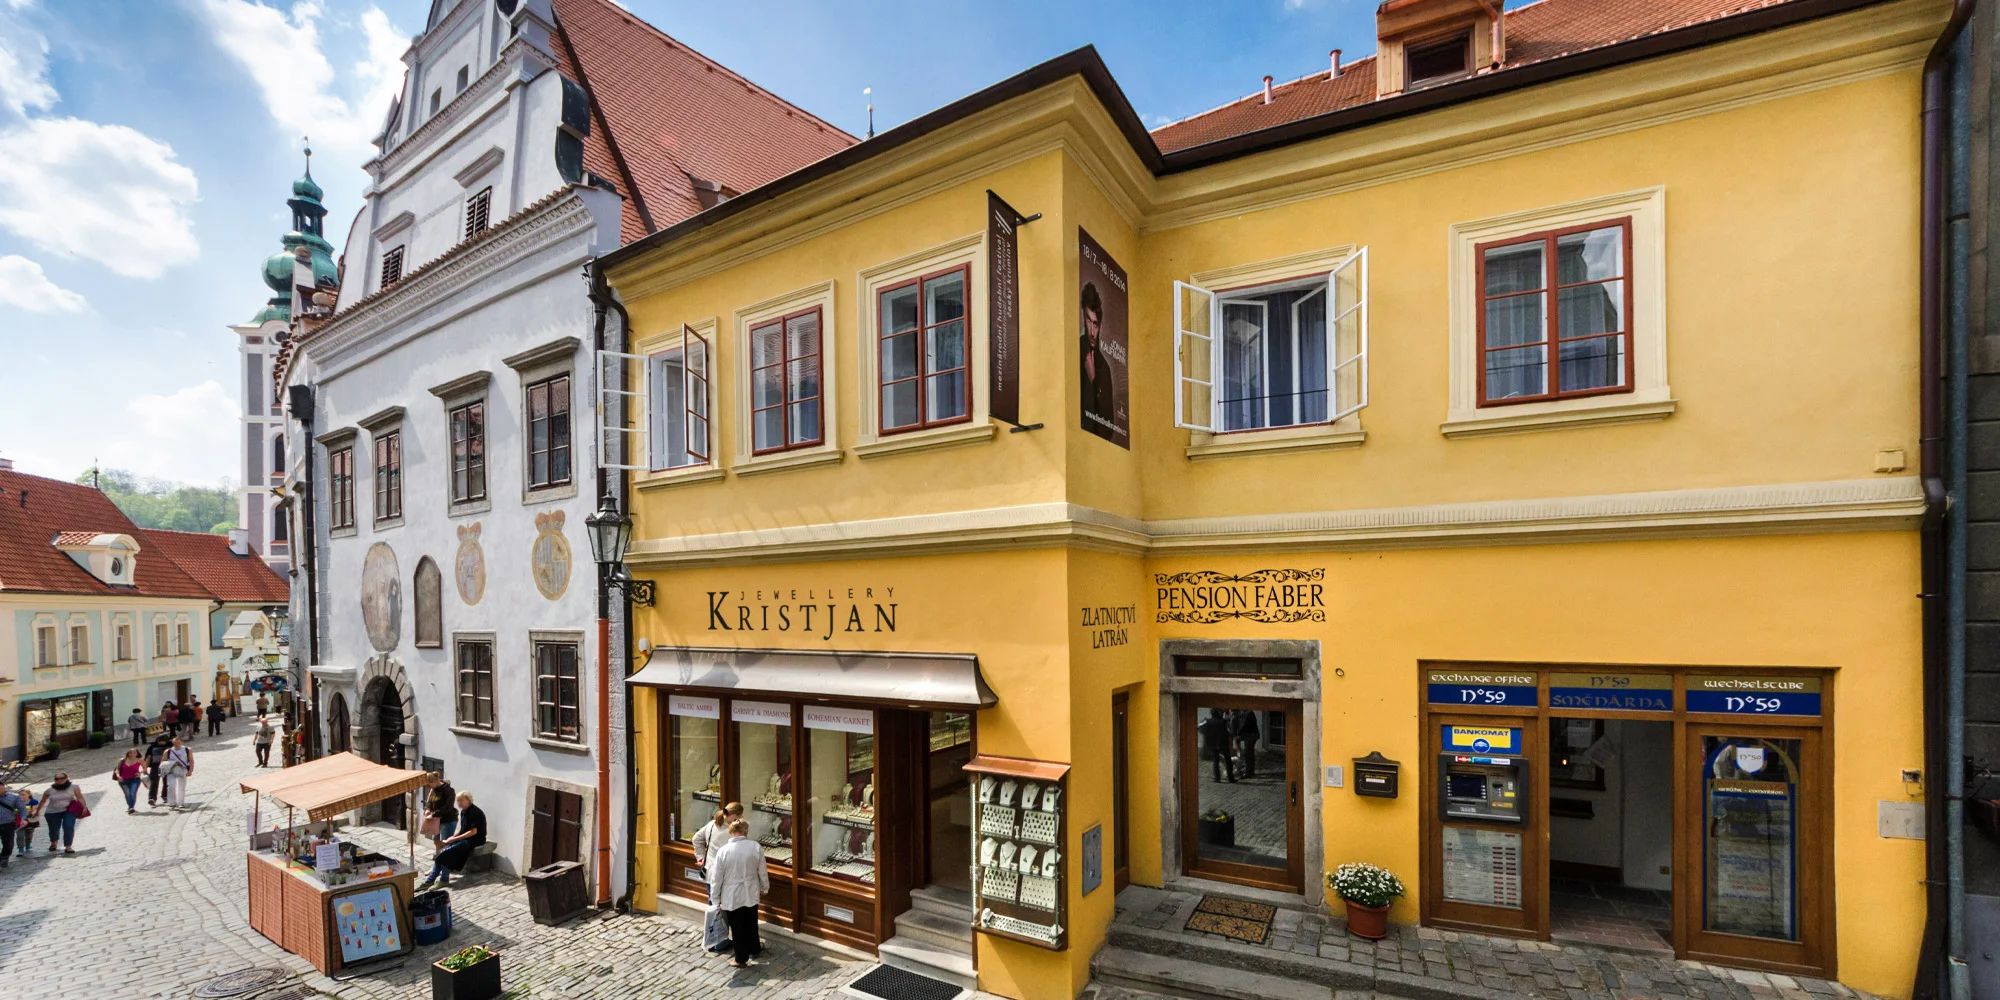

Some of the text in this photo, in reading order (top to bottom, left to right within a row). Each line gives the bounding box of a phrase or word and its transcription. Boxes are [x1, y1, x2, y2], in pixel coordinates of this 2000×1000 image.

[740, 587, 895, 601] JEWELLERY
[1157, 584, 1326, 609] PENSION FABER
[706, 591, 899, 641] KRISTJAN
[1081, 603, 1137, 627] ZLATNICTVÍ
[1092, 625, 1129, 649] LATRÁN
[677, 702, 714, 712] BALTIC AMBER
[733, 706, 755, 716] GARNET
[807, 713, 871, 726] BOHEMIAN GARNET
[1453, 728, 1510, 736] BANKOMAT
